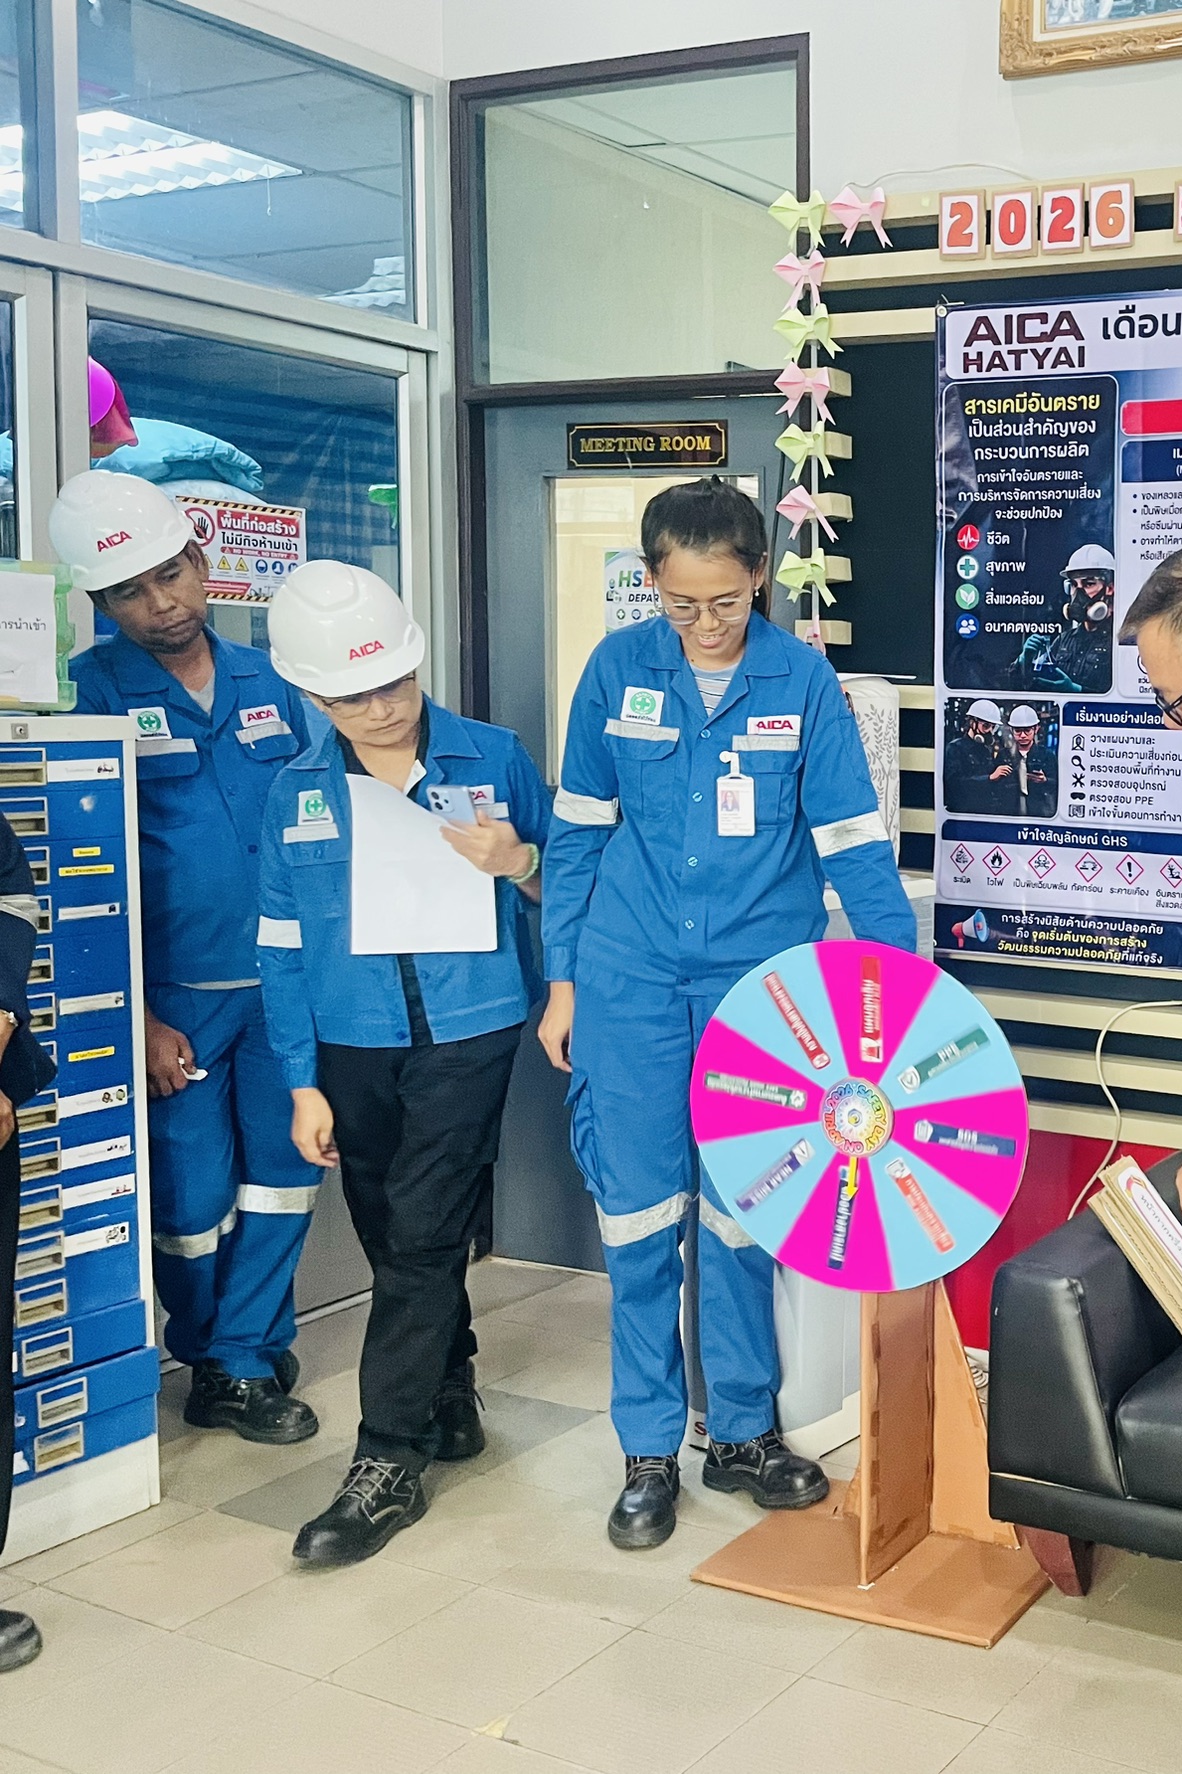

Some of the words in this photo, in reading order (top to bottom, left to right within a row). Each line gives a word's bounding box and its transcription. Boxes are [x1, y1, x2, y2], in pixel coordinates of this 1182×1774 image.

[942, 190, 1125, 247] 2026
[963, 310, 1085, 347] AICA
[963, 345, 1086, 373] HATYAI
[964, 392, 1100, 415] สารเคมีอันตราย
[968, 417, 1096, 438] เป็นส่วนสำคัญของ
[580, 436, 655, 453] MEETING
[659, 435, 712, 451] ROOM
[974, 441, 1090, 461] กระบวนการผลิต
[977, 468, 1083, 483] การเข้าใจอันตรายและ
[958, 481, 1101, 501] การบริหารจัดการความเสี่ยง
[994, 505, 1063, 520] จะช่วยปกป้อง
[221, 510, 297, 536] พื้นที่ก่อสร้าง
[97, 530, 132, 552] AICA
[221, 531, 298, 552] ไม่มีกิจห้ามเข้า
[986, 531, 1010, 545] ชีวิต
[985, 560, 1026, 576] สุขภาพ
[618, 570, 654, 588] HSE
[985, 588, 1044, 605] สิ่งแวดล้อม
[0, 618, 46, 631] ารนำเข้า
[984, 621, 1062, 634] อนาคตของเรา
[349, 640, 385, 661] AICA
[246, 708, 276, 721] AICA
[756, 719, 793, 730] AICA
[1089, 793, 1131, 804] ตรวจสอบ
[1134, 796, 1154, 806] PPE
[1017, 827, 1098, 846] เข้าใจสัญลักษณ์
[1101, 835, 1129, 848] GHS
[1001, 911, 1164, 935] การสร้างนิสัยด้านความปลอดภัย
[1016, 928, 1030, 939] คือ
[1031, 929, 1147, 948] จุดเริ่มต้นของการสร้าง
